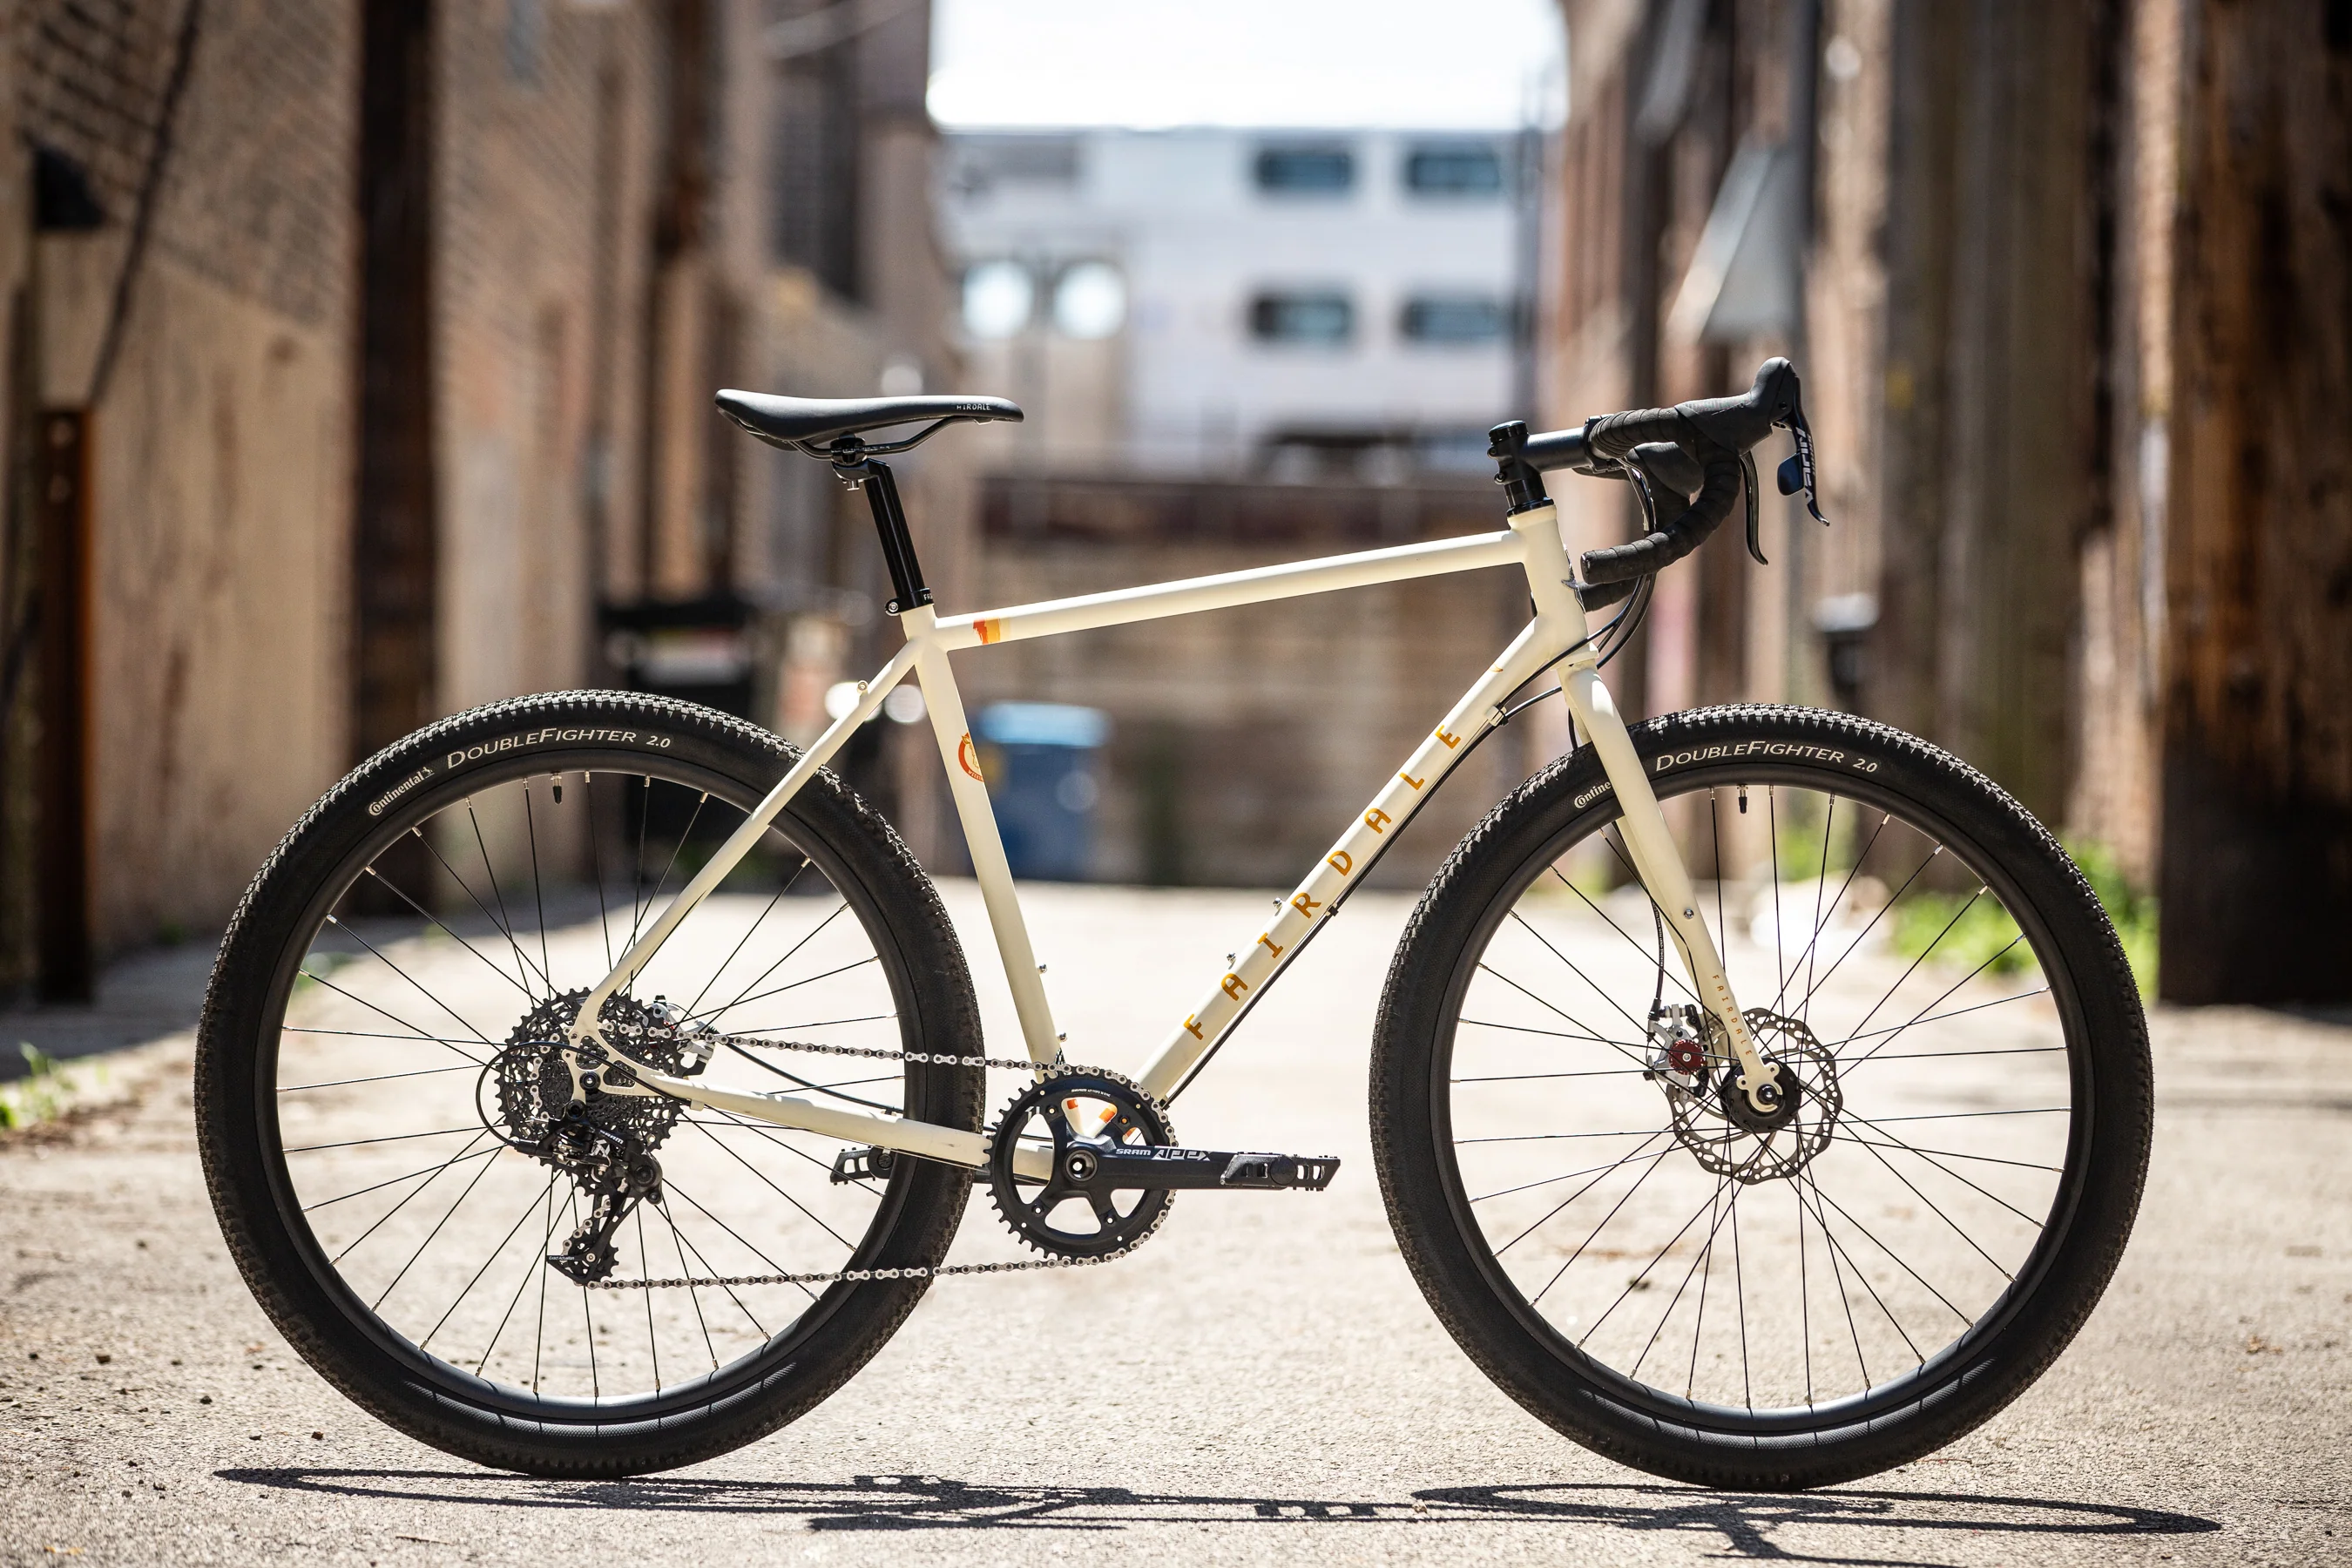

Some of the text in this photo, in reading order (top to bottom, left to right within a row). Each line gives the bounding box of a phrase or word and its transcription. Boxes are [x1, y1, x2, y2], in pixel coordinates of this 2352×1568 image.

[368, 727, 671, 816] Continental DOUBLEFIGHTER 2.0
[1656, 740, 1845, 772] DOUBLEFIGHTER
[1852, 758, 1878, 774] 2.0
[1183, 725, 1461, 1040] FAIRDALE
[1713, 974, 1753, 1056] FAIRDALE
